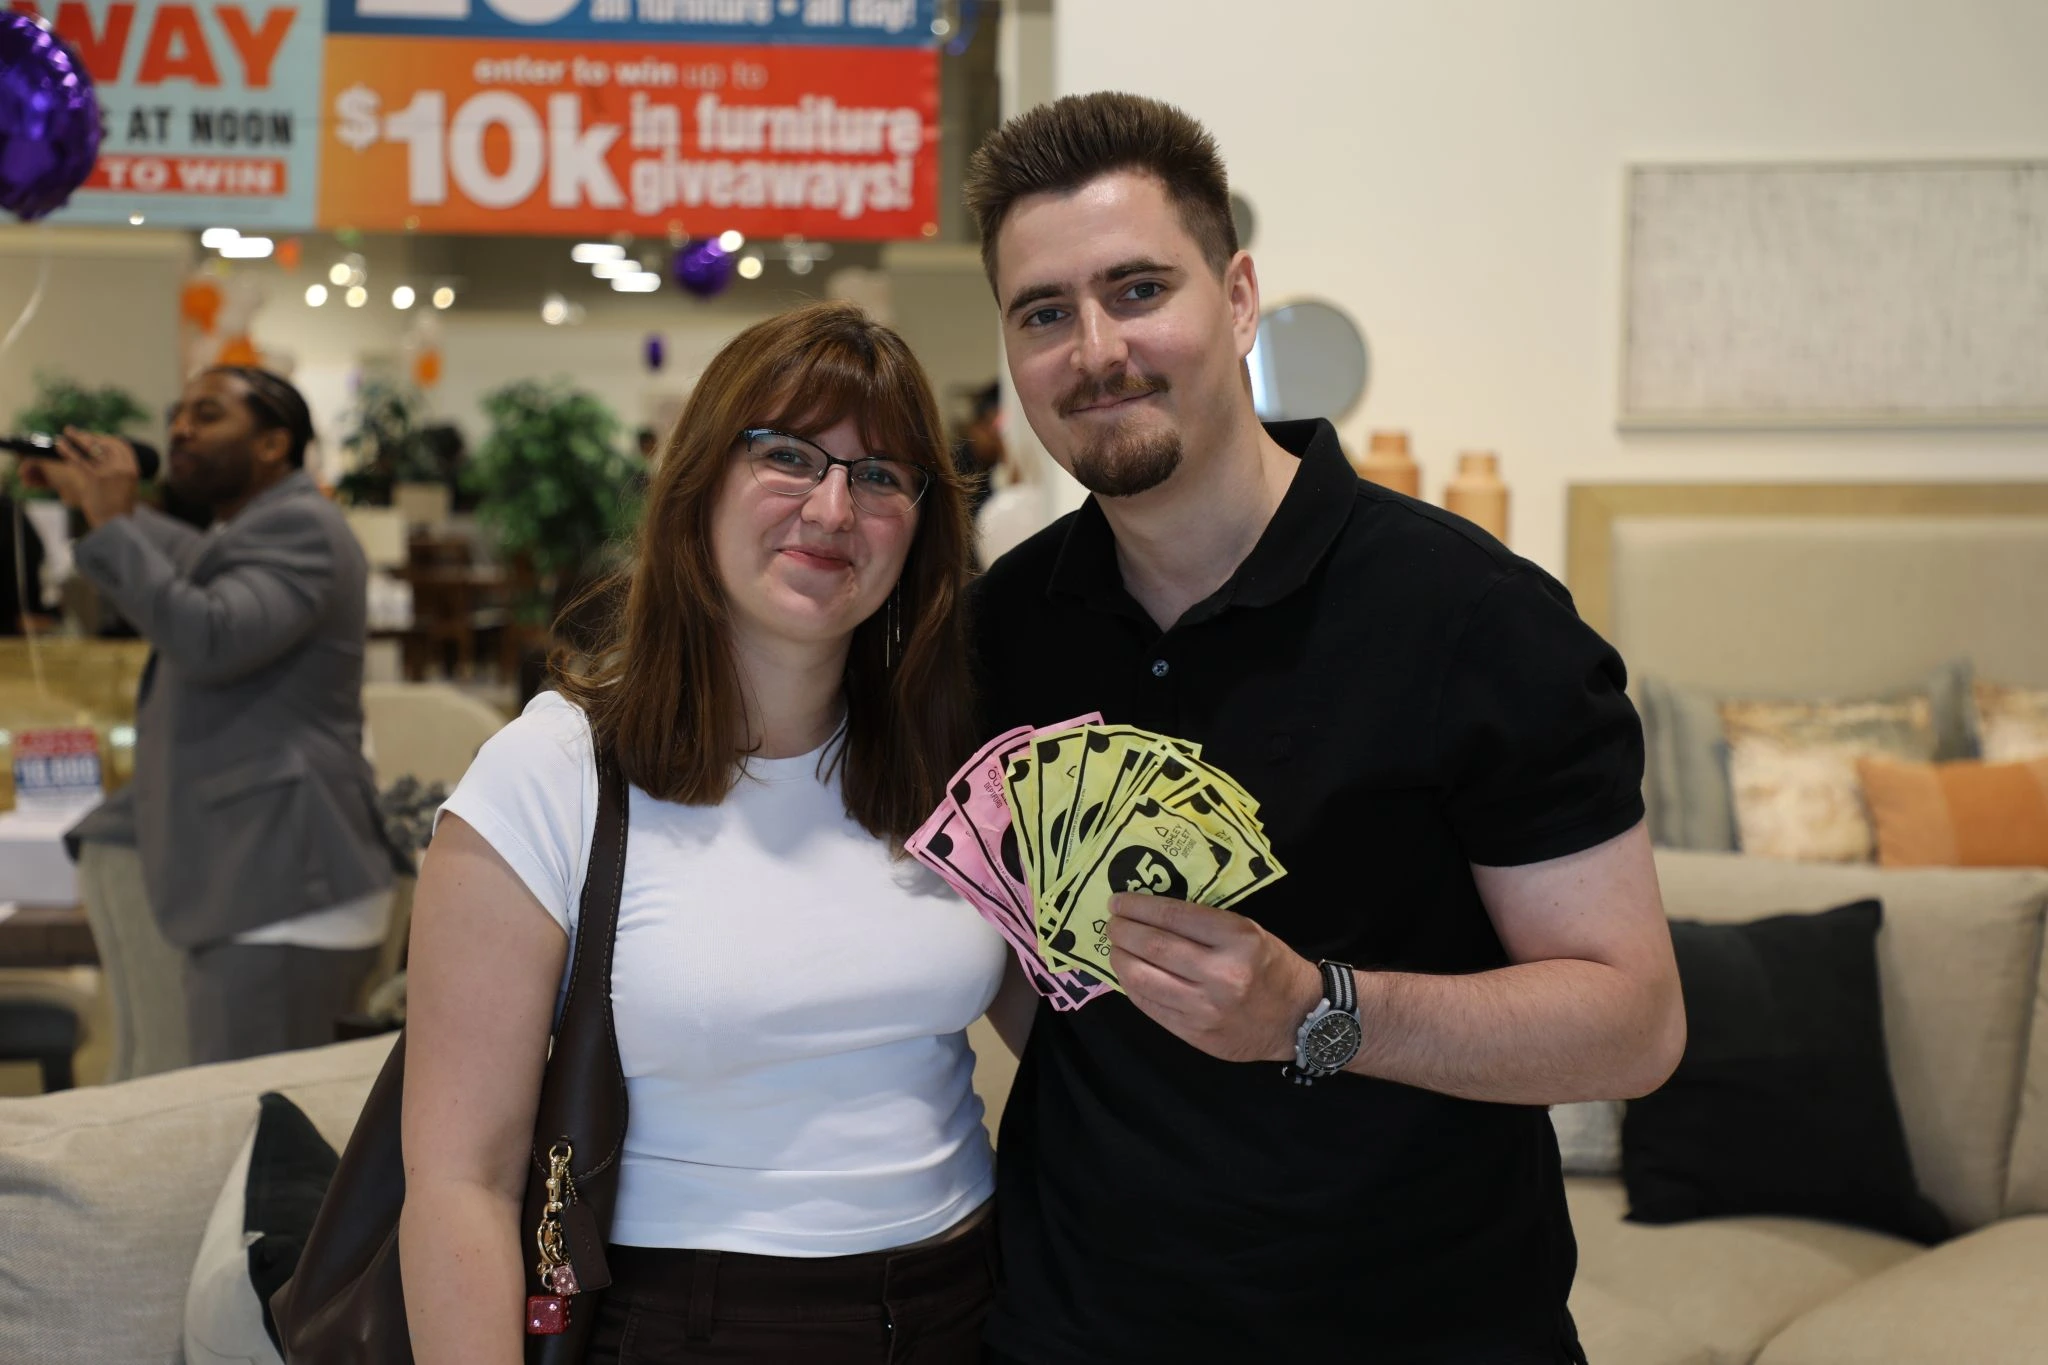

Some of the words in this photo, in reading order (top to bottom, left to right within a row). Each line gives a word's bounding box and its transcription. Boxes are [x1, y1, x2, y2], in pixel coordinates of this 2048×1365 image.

[473, 54, 565, 86] enter
[572, 54, 611, 87] to
[614, 56, 677, 87] win
[682, 61, 728, 90] up
[731, 58, 769, 90] to
[127, 104, 172, 144] AT
[189, 107, 293, 147] NOON
[630, 92, 681, 149] in
[696, 93, 921, 154] furniture
[105, 158, 169, 191] TO
[177, 160, 276, 191] WIN
[630, 146, 915, 220] giveaways!
[1162, 824, 1182, 852] ASHLEY
[1169, 829, 1191, 857] OUTLET
